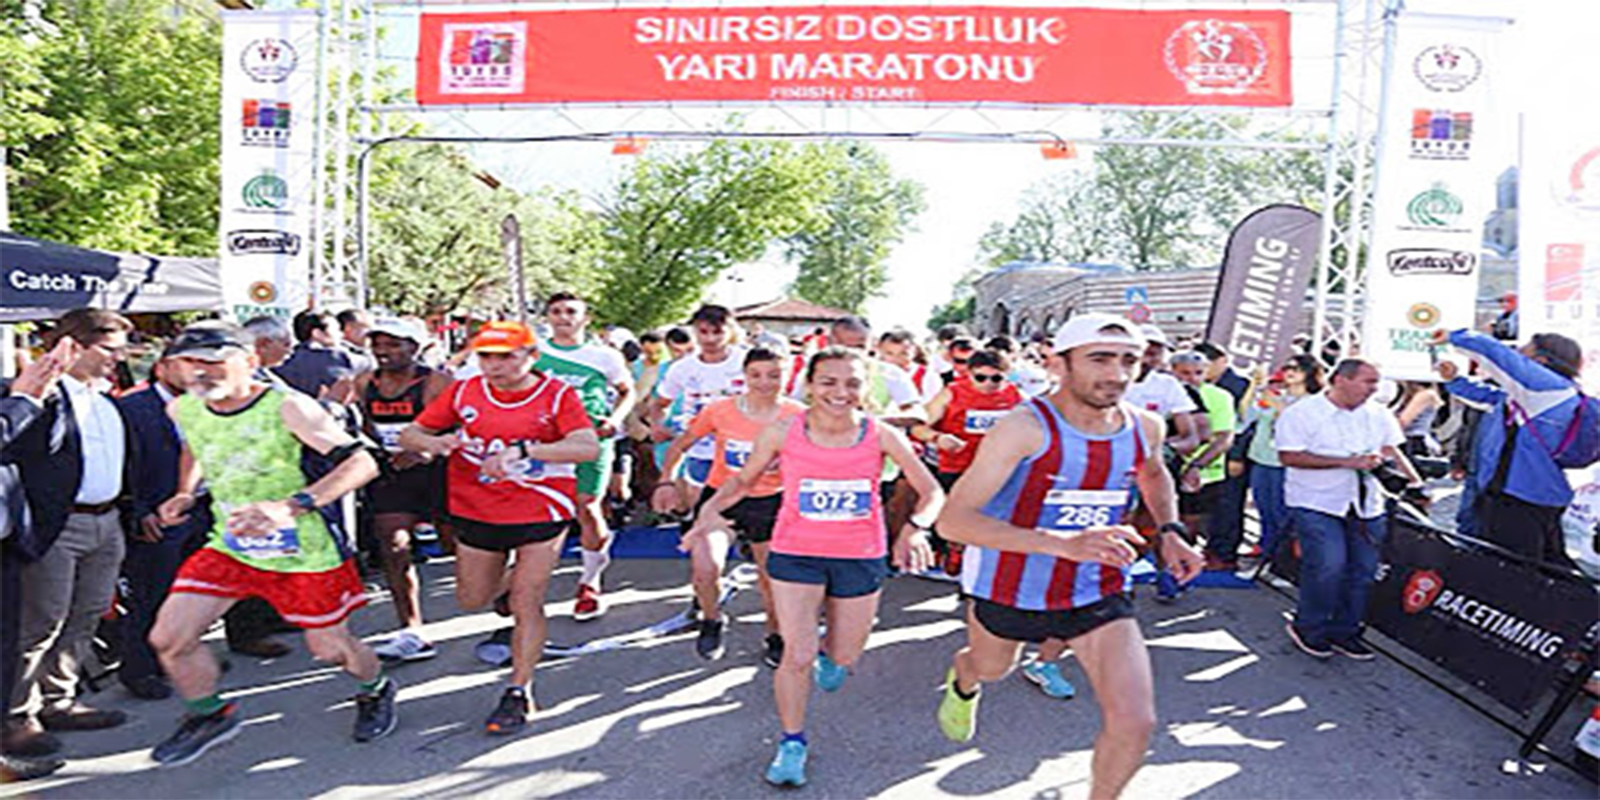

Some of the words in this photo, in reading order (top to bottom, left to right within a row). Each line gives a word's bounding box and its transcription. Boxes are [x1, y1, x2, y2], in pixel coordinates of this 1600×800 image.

[634, 15, 822, 44] SINIRSIZ
[836, 15, 1061, 45] DOSTLUK
[656, 52, 757, 81] YARI
[770, 52, 1035, 83] MARATONU
[9, 269, 76, 292] Catch
[80, 274, 123, 293] The
[811, 491, 858, 510] 072
[1055, 505, 1111, 527] 286
[1433, 589, 1564, 658] RACETIMING
